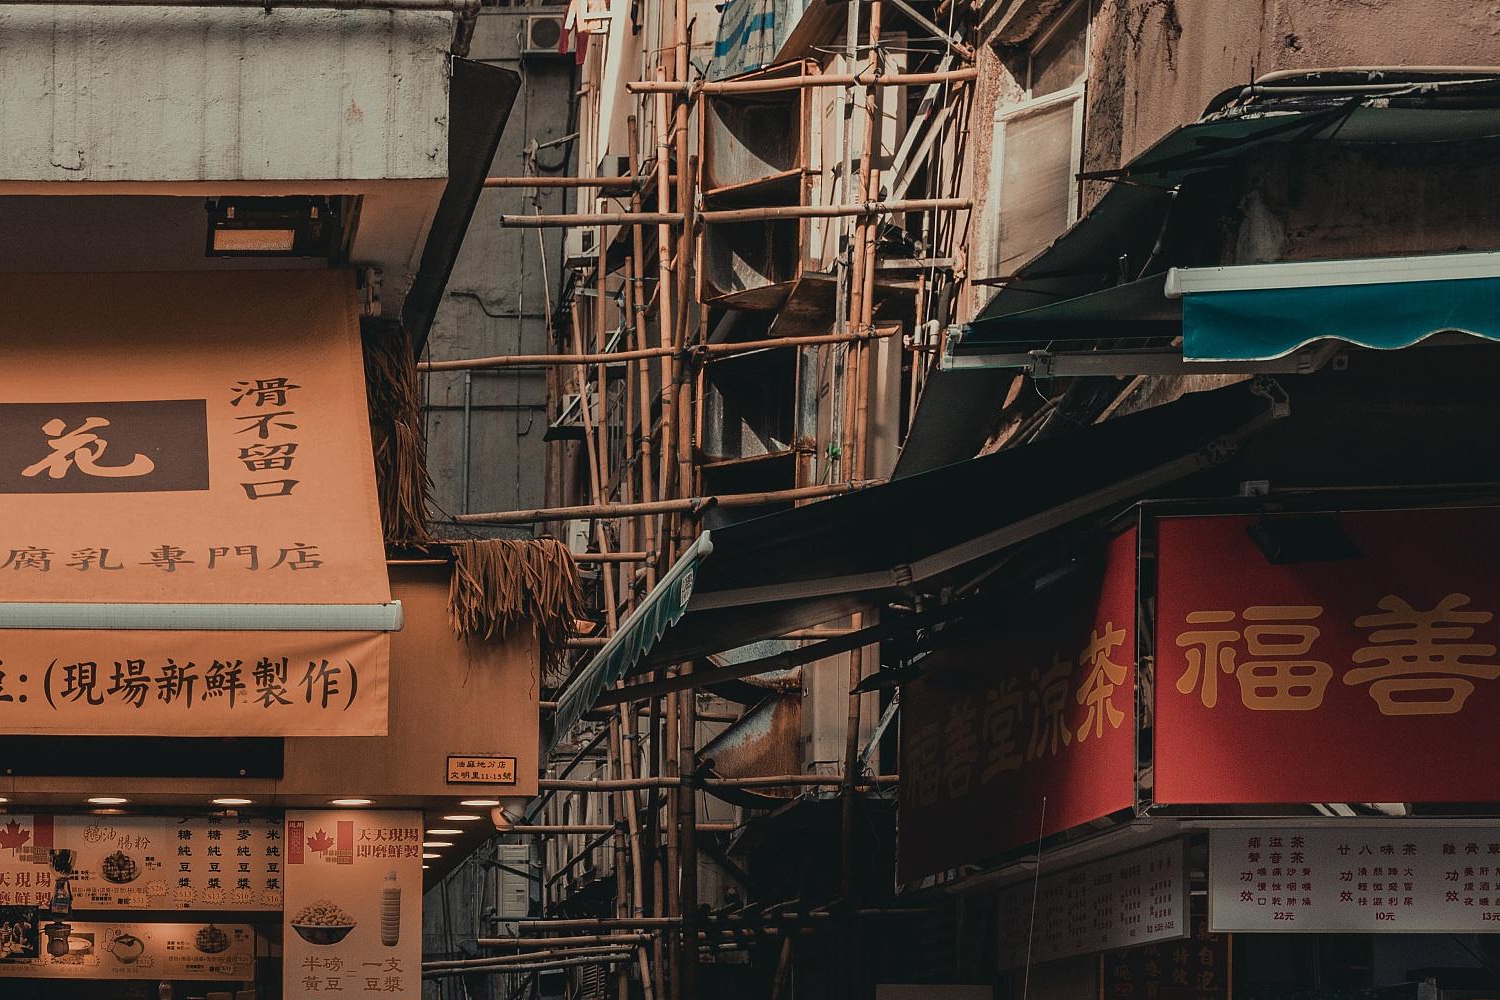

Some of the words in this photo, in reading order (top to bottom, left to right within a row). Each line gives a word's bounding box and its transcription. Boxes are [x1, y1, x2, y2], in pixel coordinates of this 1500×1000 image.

[231, 376, 302, 502] 滑不留口
[1175, 592, 1500, 716] 福善
[358, 828, 419, 842] 天天現場
[357, 845, 419, 859] 即磨鮮製
[1337, 844, 1417, 856] 廿八味茶
[1240, 870, 1254, 902] 功效
[1339, 870, 1353, 902] 功效
[1445, 870, 1459, 902] 功效
[1274, 912, 1295, 920] 22元
[1375, 912, 1396, 921] 10元
[301, 956, 343, 972] 半磅
[362, 957, 404, 973] 一支
[301, 976, 343, 991] 黃豆
[364, 976, 404, 992] 豆漿
